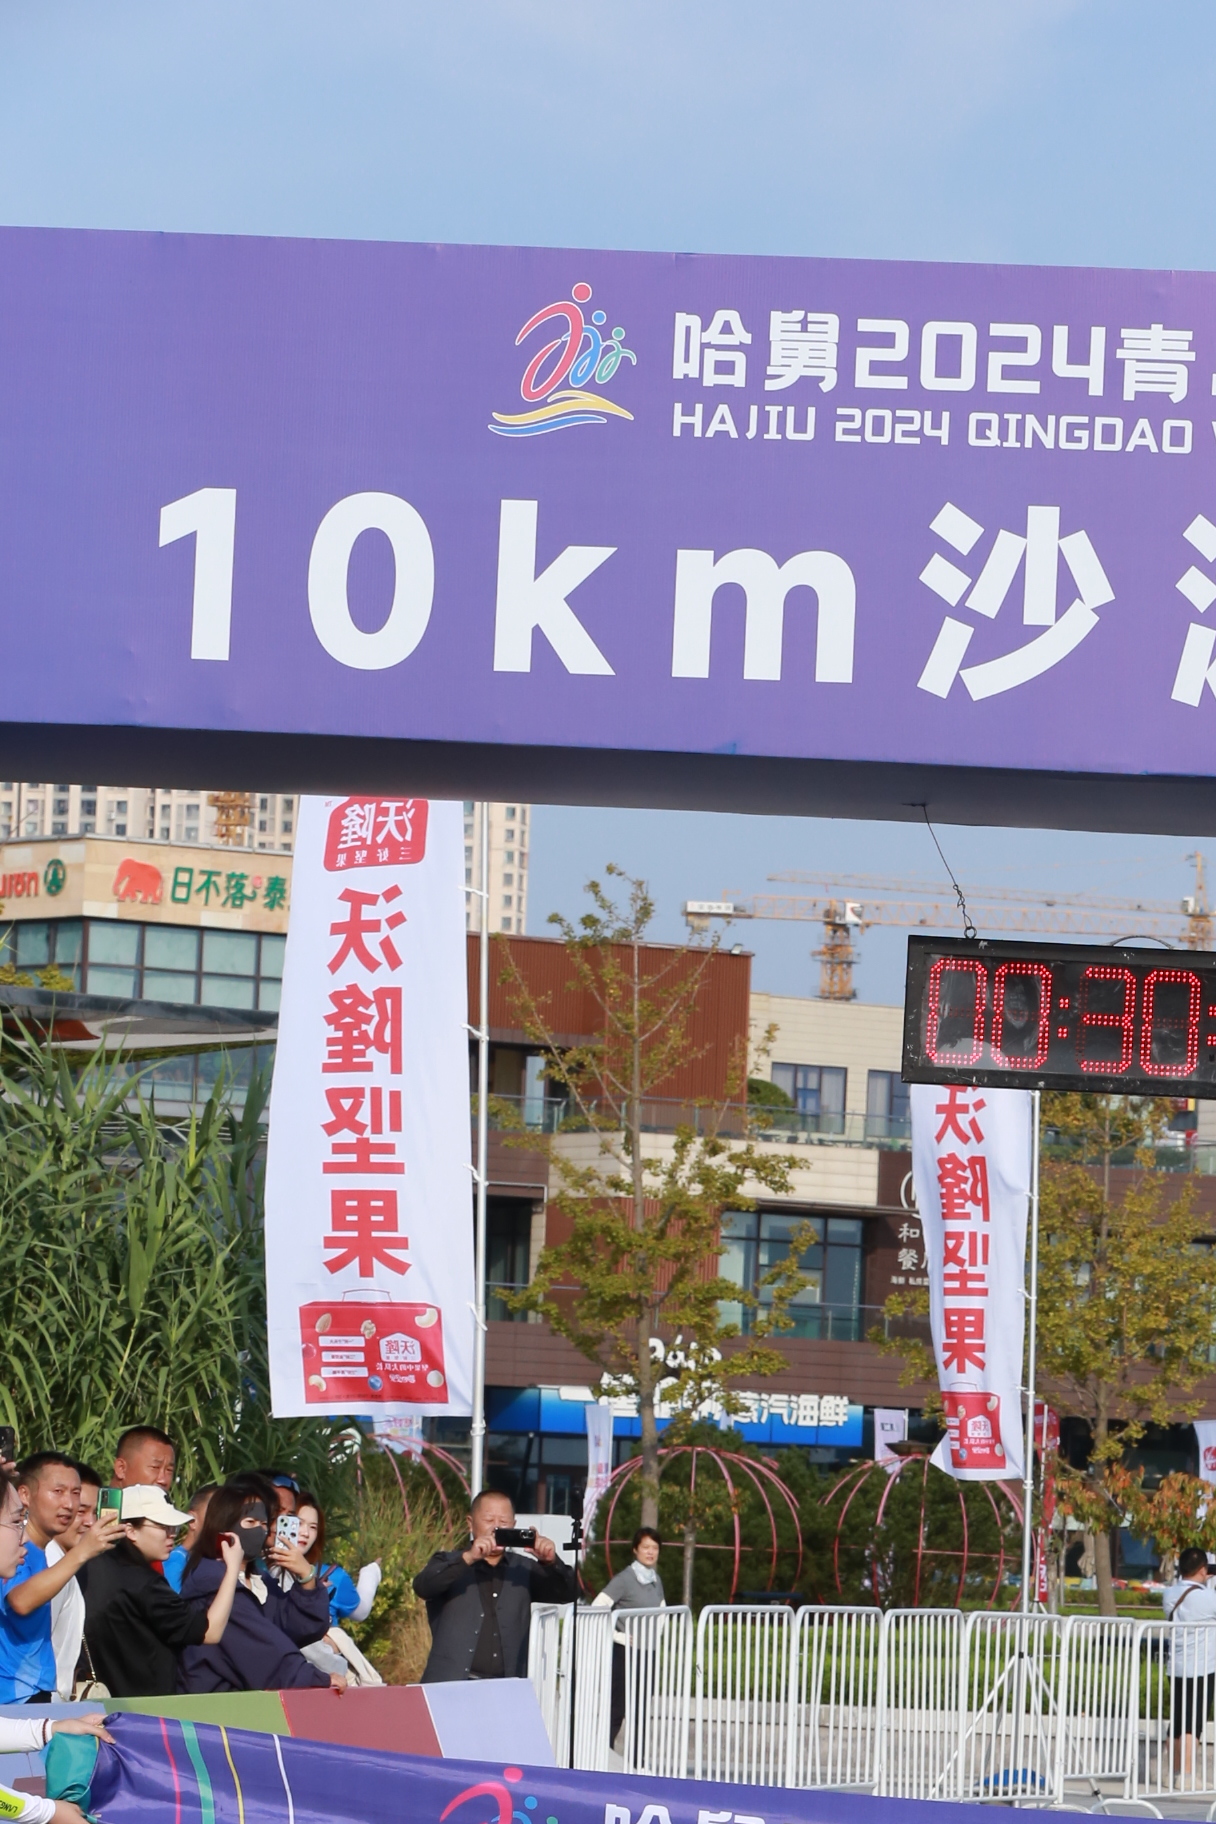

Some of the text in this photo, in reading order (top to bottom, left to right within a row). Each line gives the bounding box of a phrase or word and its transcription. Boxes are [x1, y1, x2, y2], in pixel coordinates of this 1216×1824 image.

[835, 407, 951, 446] 2024
[967, 412, 1193, 455] QINGDAO
[170, 864, 291, 912] 日不落泰
